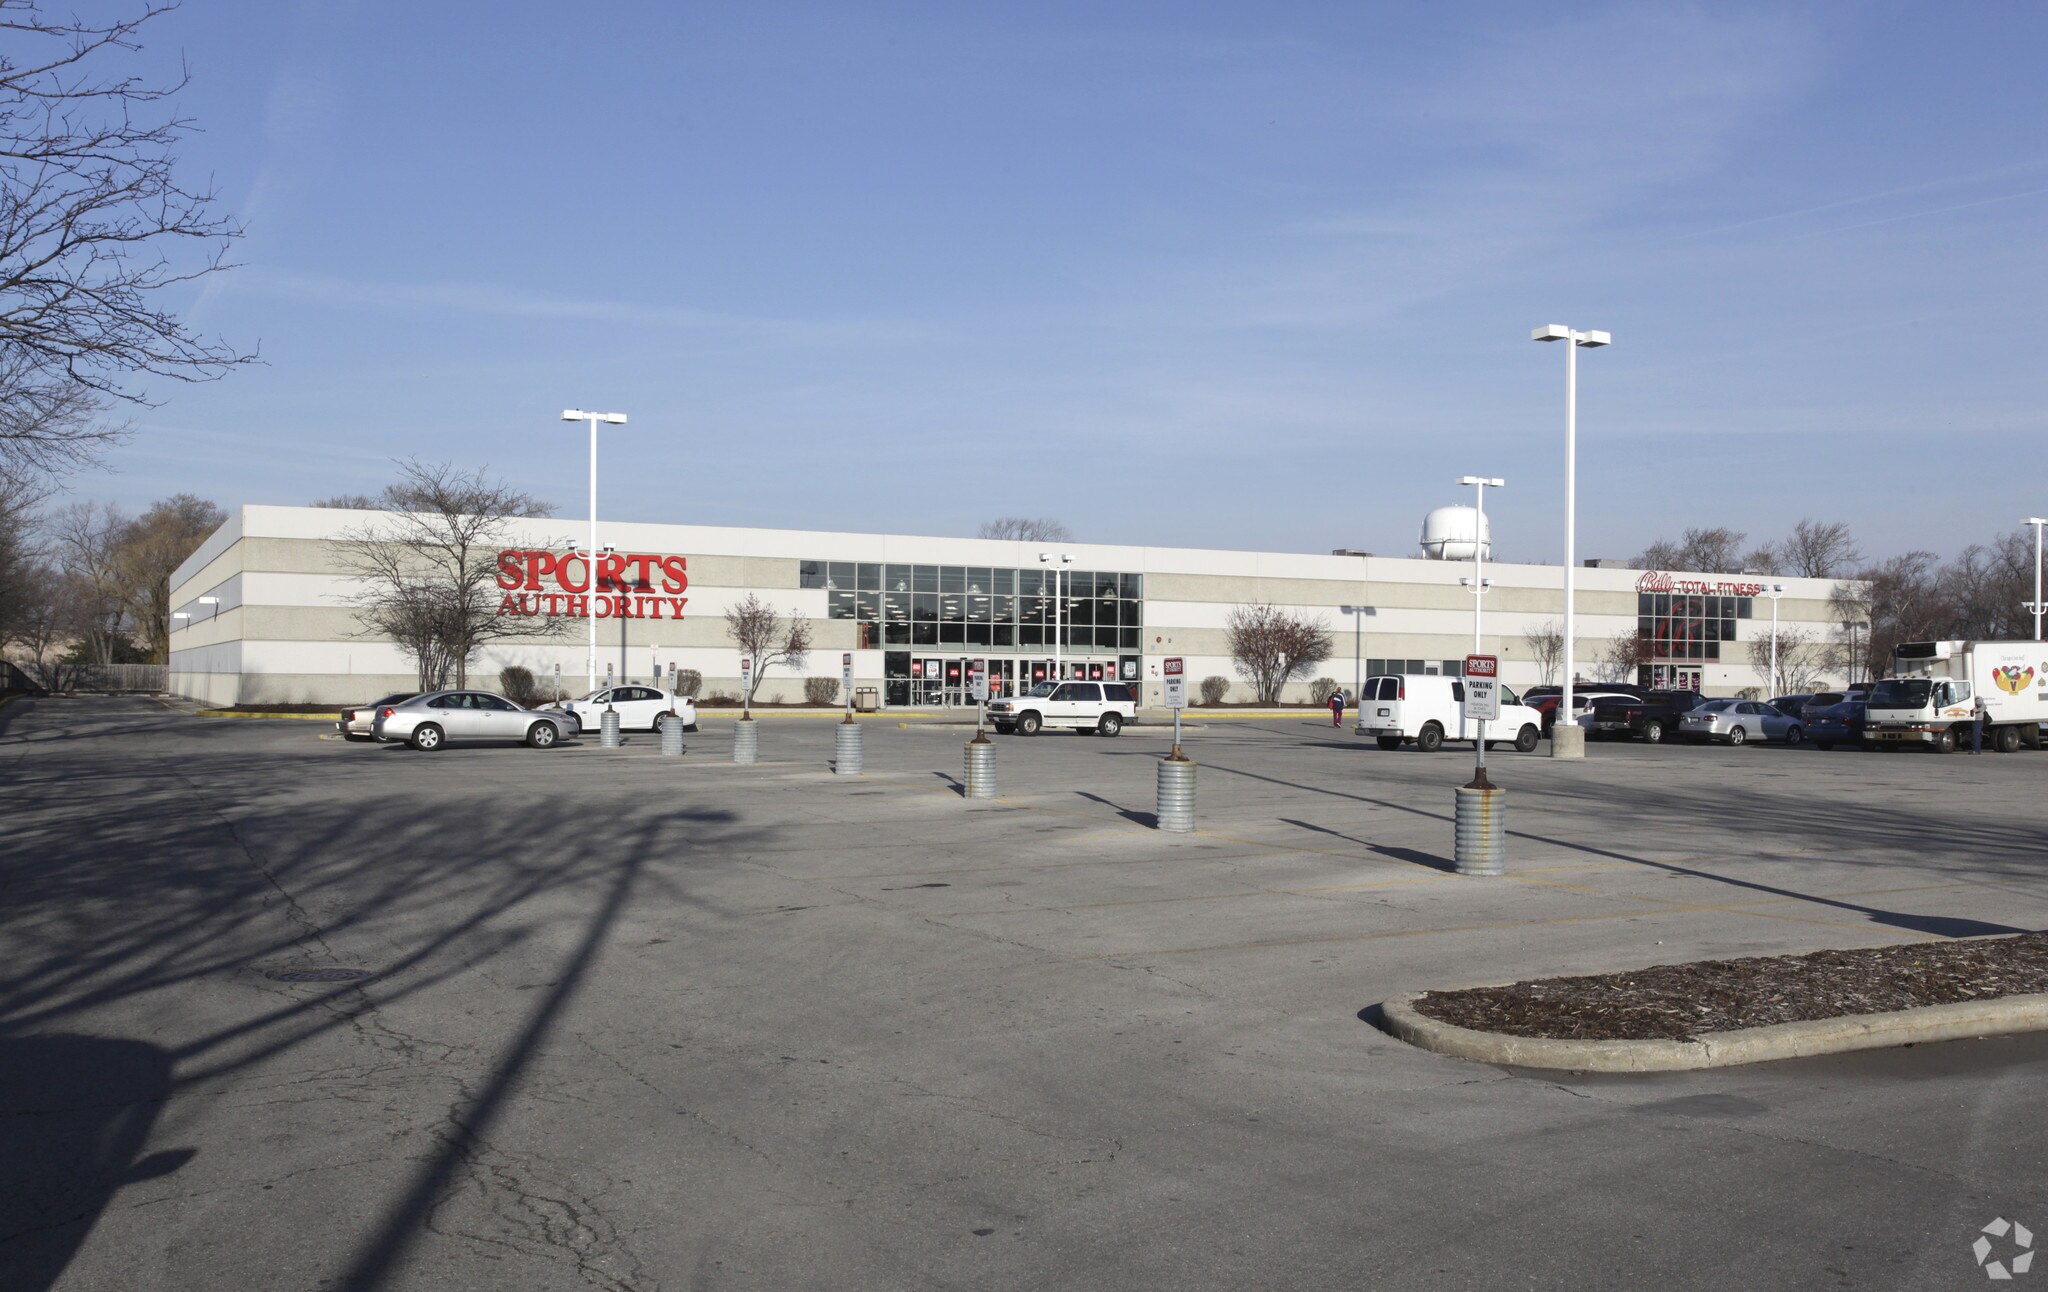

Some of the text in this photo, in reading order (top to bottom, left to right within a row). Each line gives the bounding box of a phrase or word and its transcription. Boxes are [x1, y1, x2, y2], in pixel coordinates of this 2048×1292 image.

[496, 550, 688, 594] SPORTS
[1639, 570, 1761, 595] Bally TOTAL FITNESS
[497, 593, 688, 620] AUTHORITY
[1468, 659, 1495, 668] SPORTS
[1469, 681, 1492, 689] PARKING
